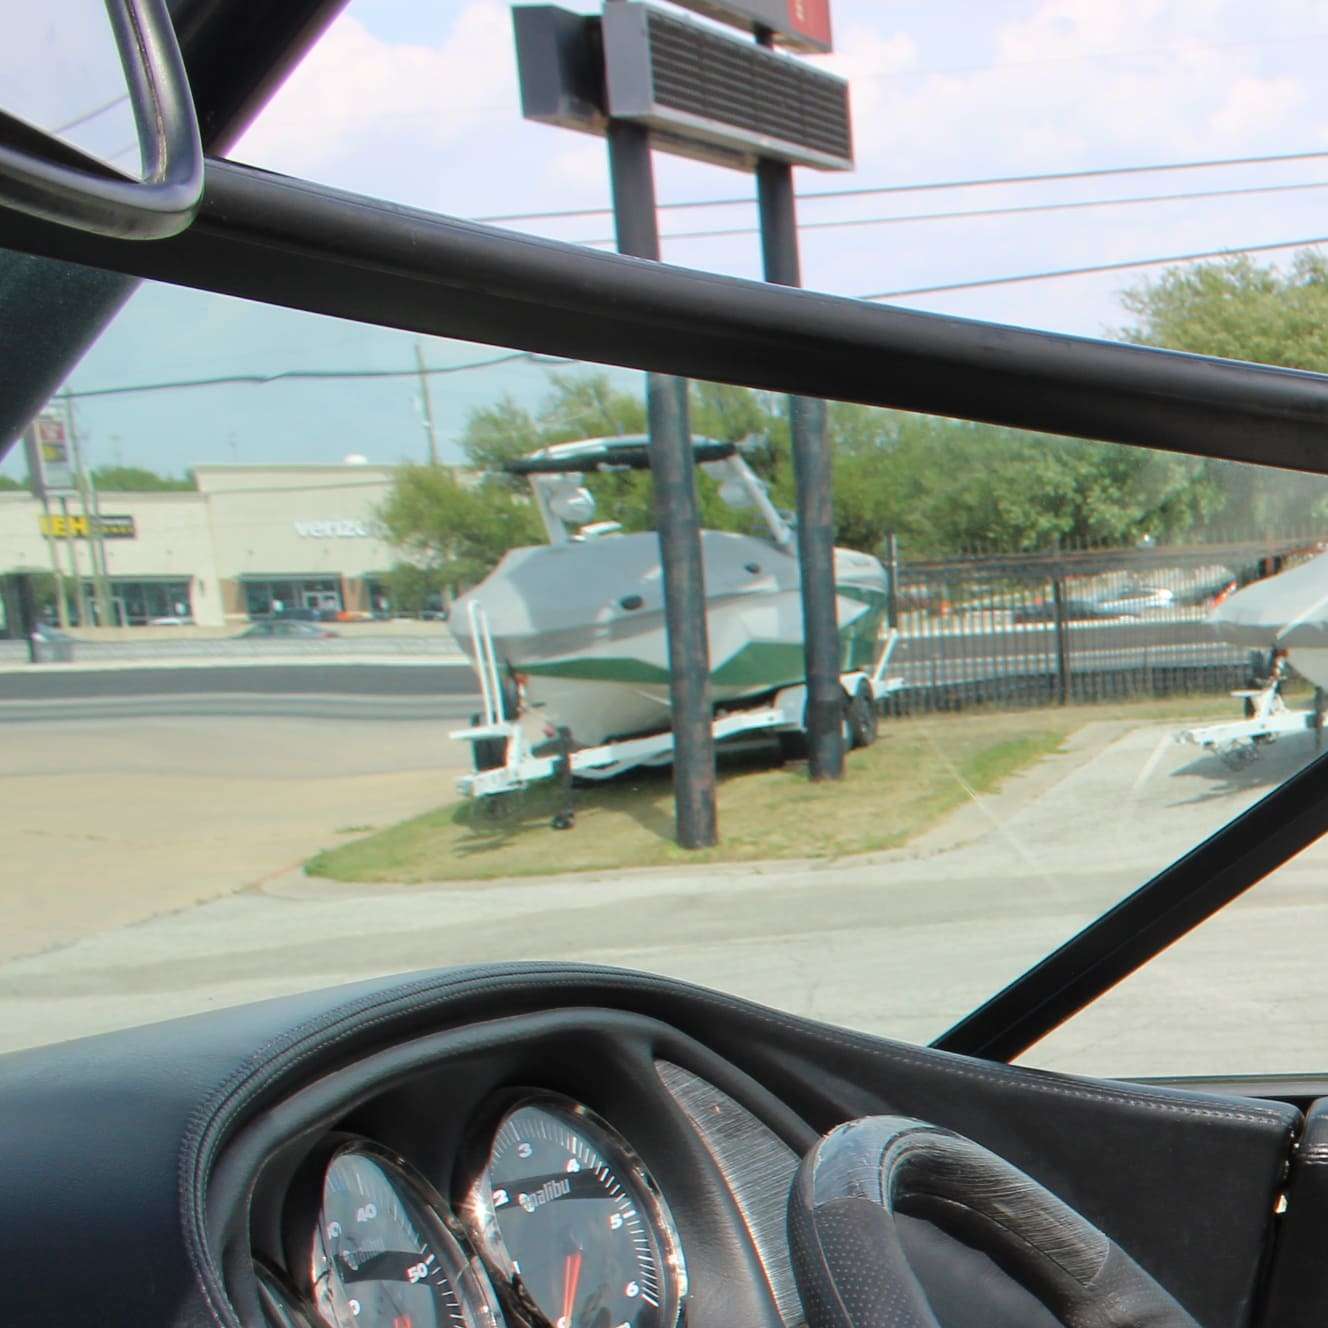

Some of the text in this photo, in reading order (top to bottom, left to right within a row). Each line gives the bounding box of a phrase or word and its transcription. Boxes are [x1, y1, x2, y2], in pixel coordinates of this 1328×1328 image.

[610, 1213, 623, 1230] 5
[407, 1261, 429, 1284] 50
[624, 1281, 639, 1297] 6
